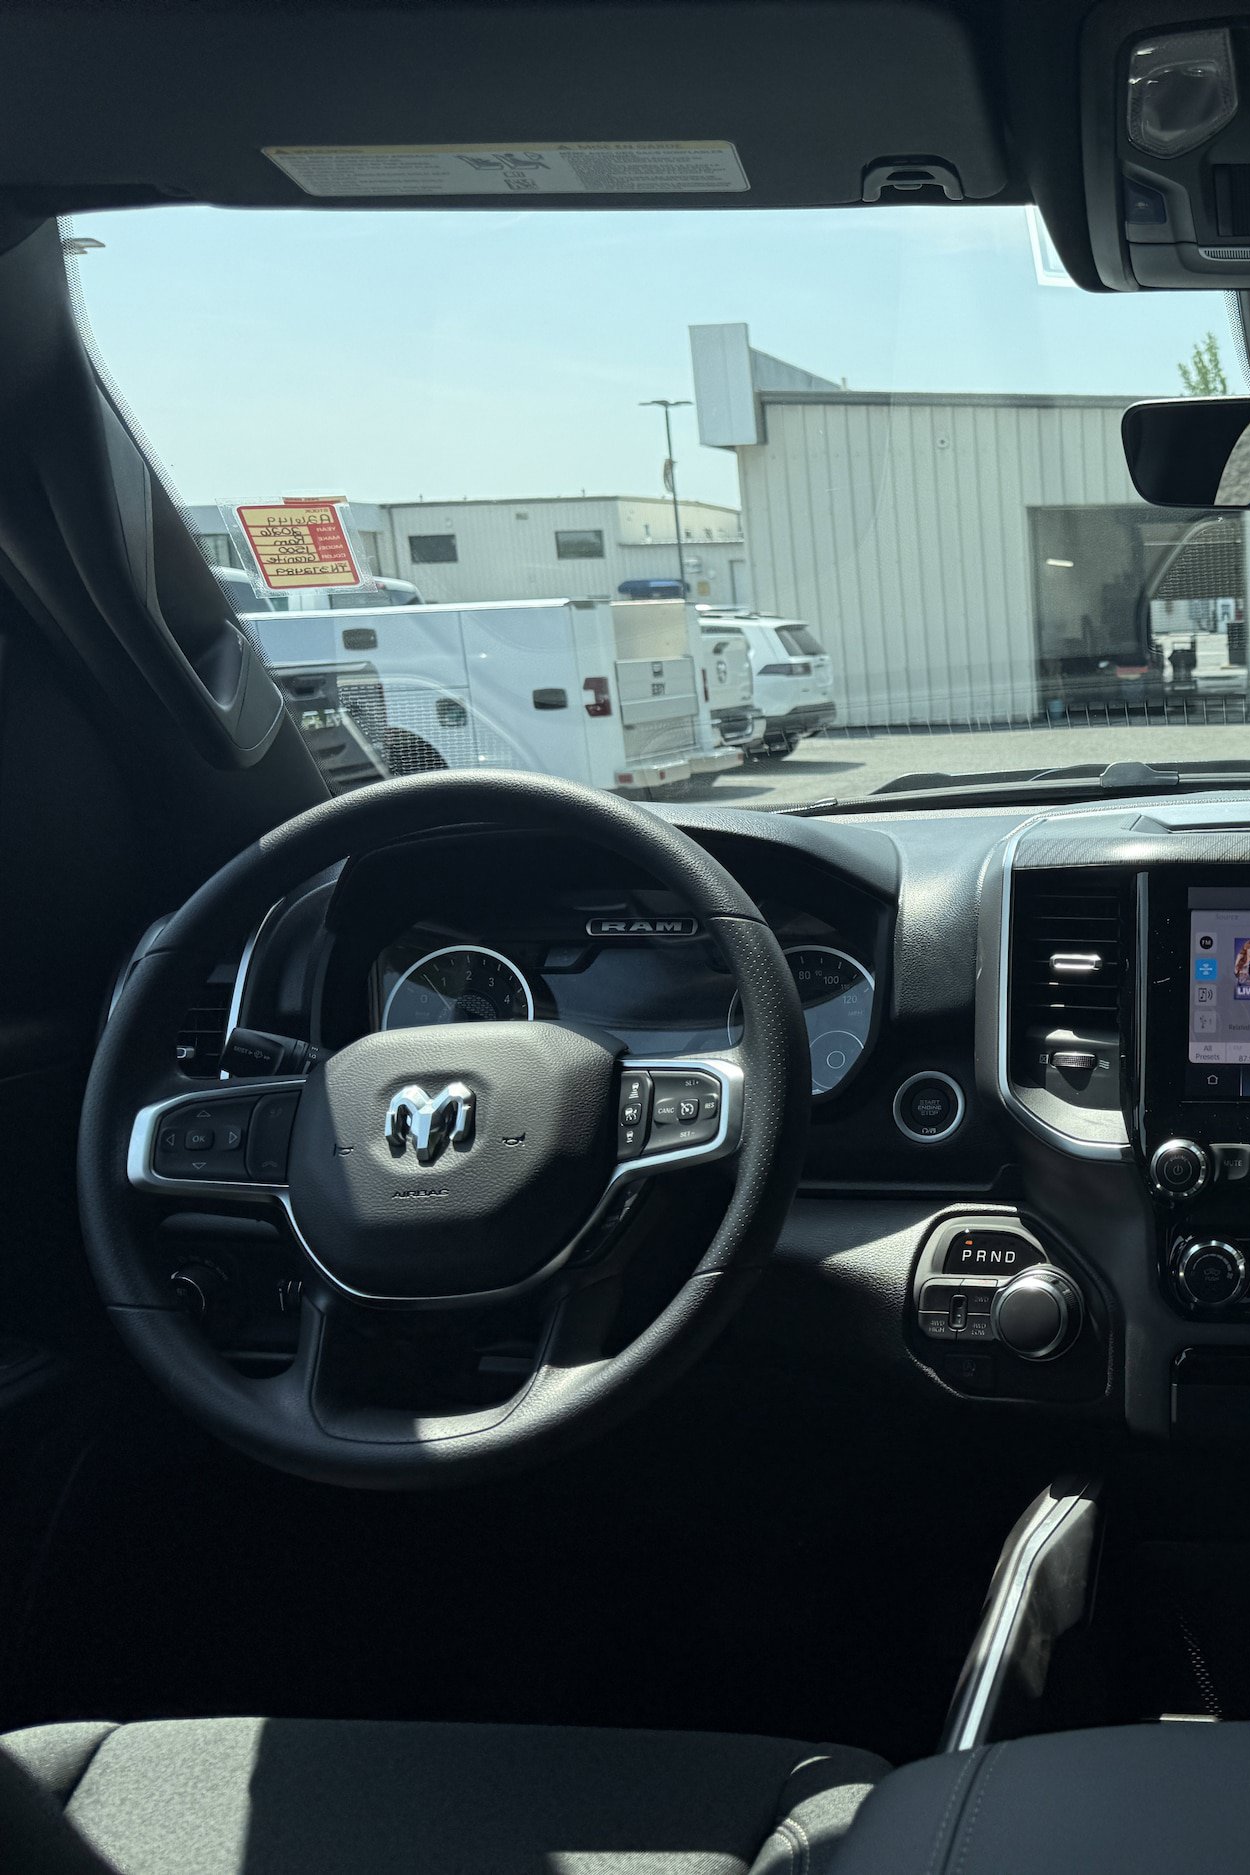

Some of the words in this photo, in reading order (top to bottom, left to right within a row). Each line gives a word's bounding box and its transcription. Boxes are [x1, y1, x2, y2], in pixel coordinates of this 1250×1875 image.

[601, 921, 683, 931] RAM
[465, 970, 473, 981] 2
[798, 971, 811, 980] 80
[440, 977, 447, 986] 1
[488, 977, 495, 987] 3
[823, 976, 840, 985] 100
[503, 994, 511, 1004] 4
[843, 996, 858, 1004] 120
[1195, 1053, 1220, 1061] Presets
[192, 1135, 206, 1143] OK
[1223, 1159, 1243, 1167] MUTE
